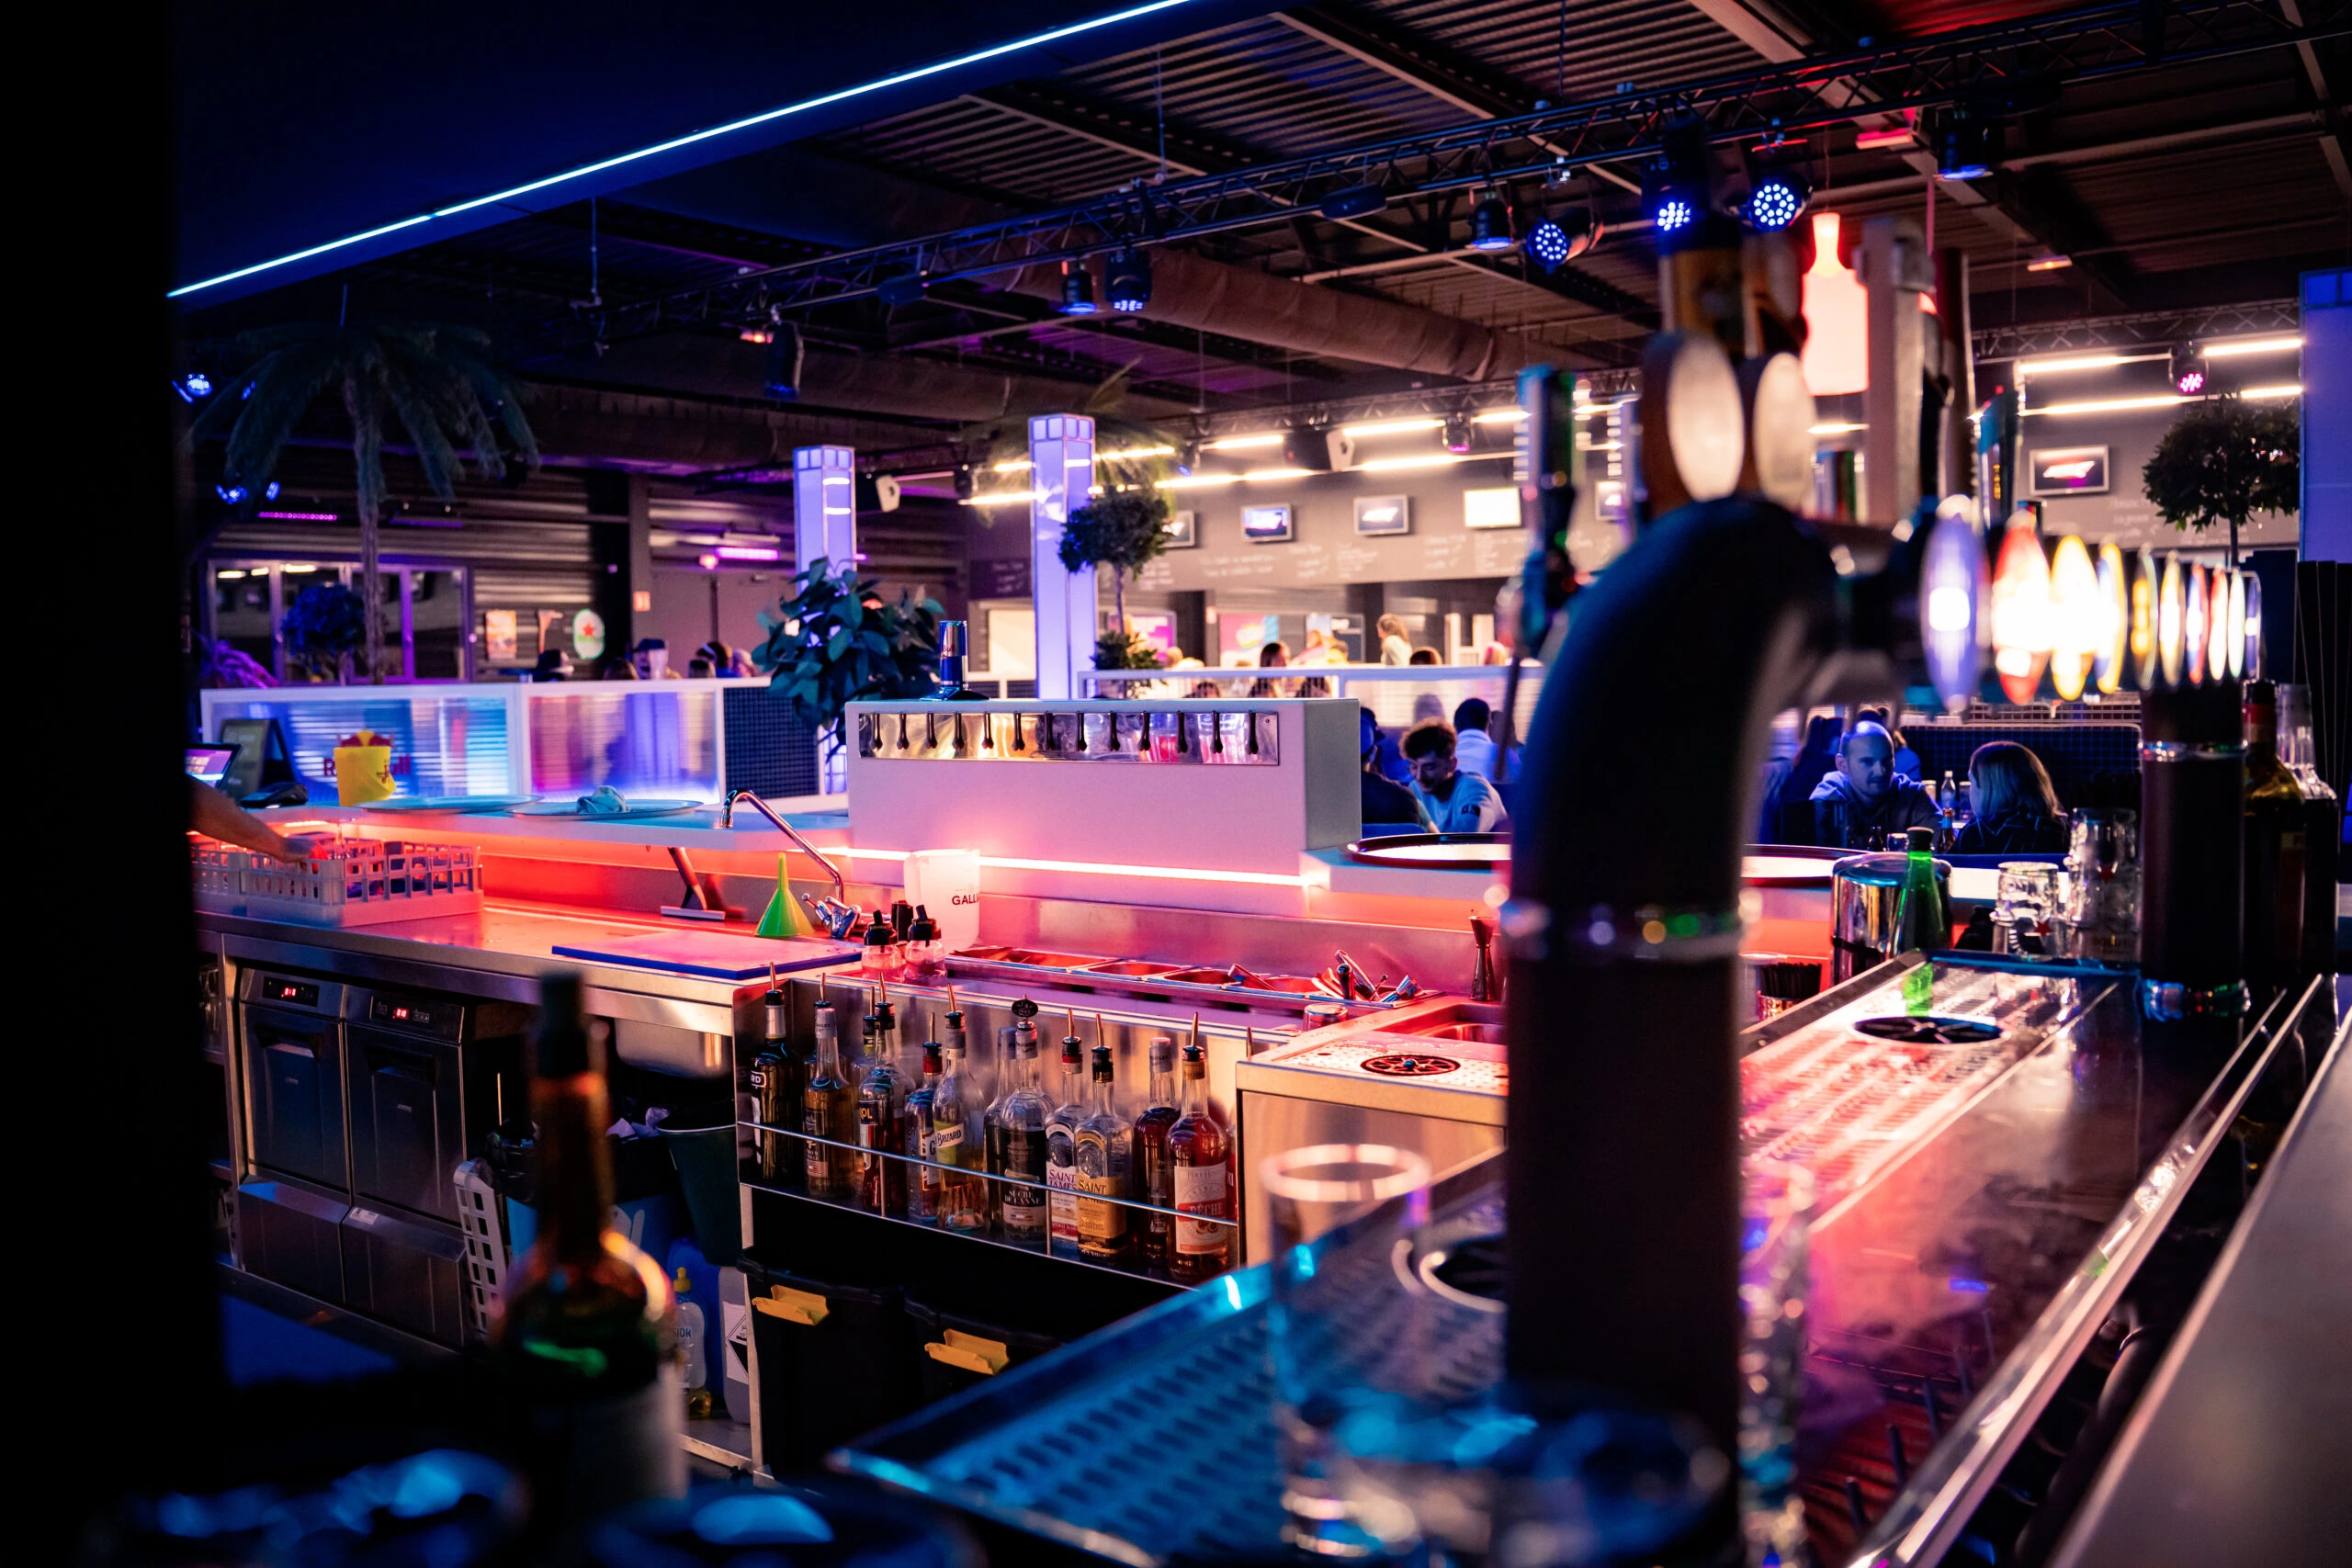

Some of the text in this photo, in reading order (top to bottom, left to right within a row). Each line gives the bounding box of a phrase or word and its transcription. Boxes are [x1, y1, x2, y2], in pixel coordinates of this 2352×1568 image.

[859, 1107, 873, 1120] OL
[1048, 1168, 1076, 1184] SAINT
[1078, 1179, 1107, 1194] SAINT
